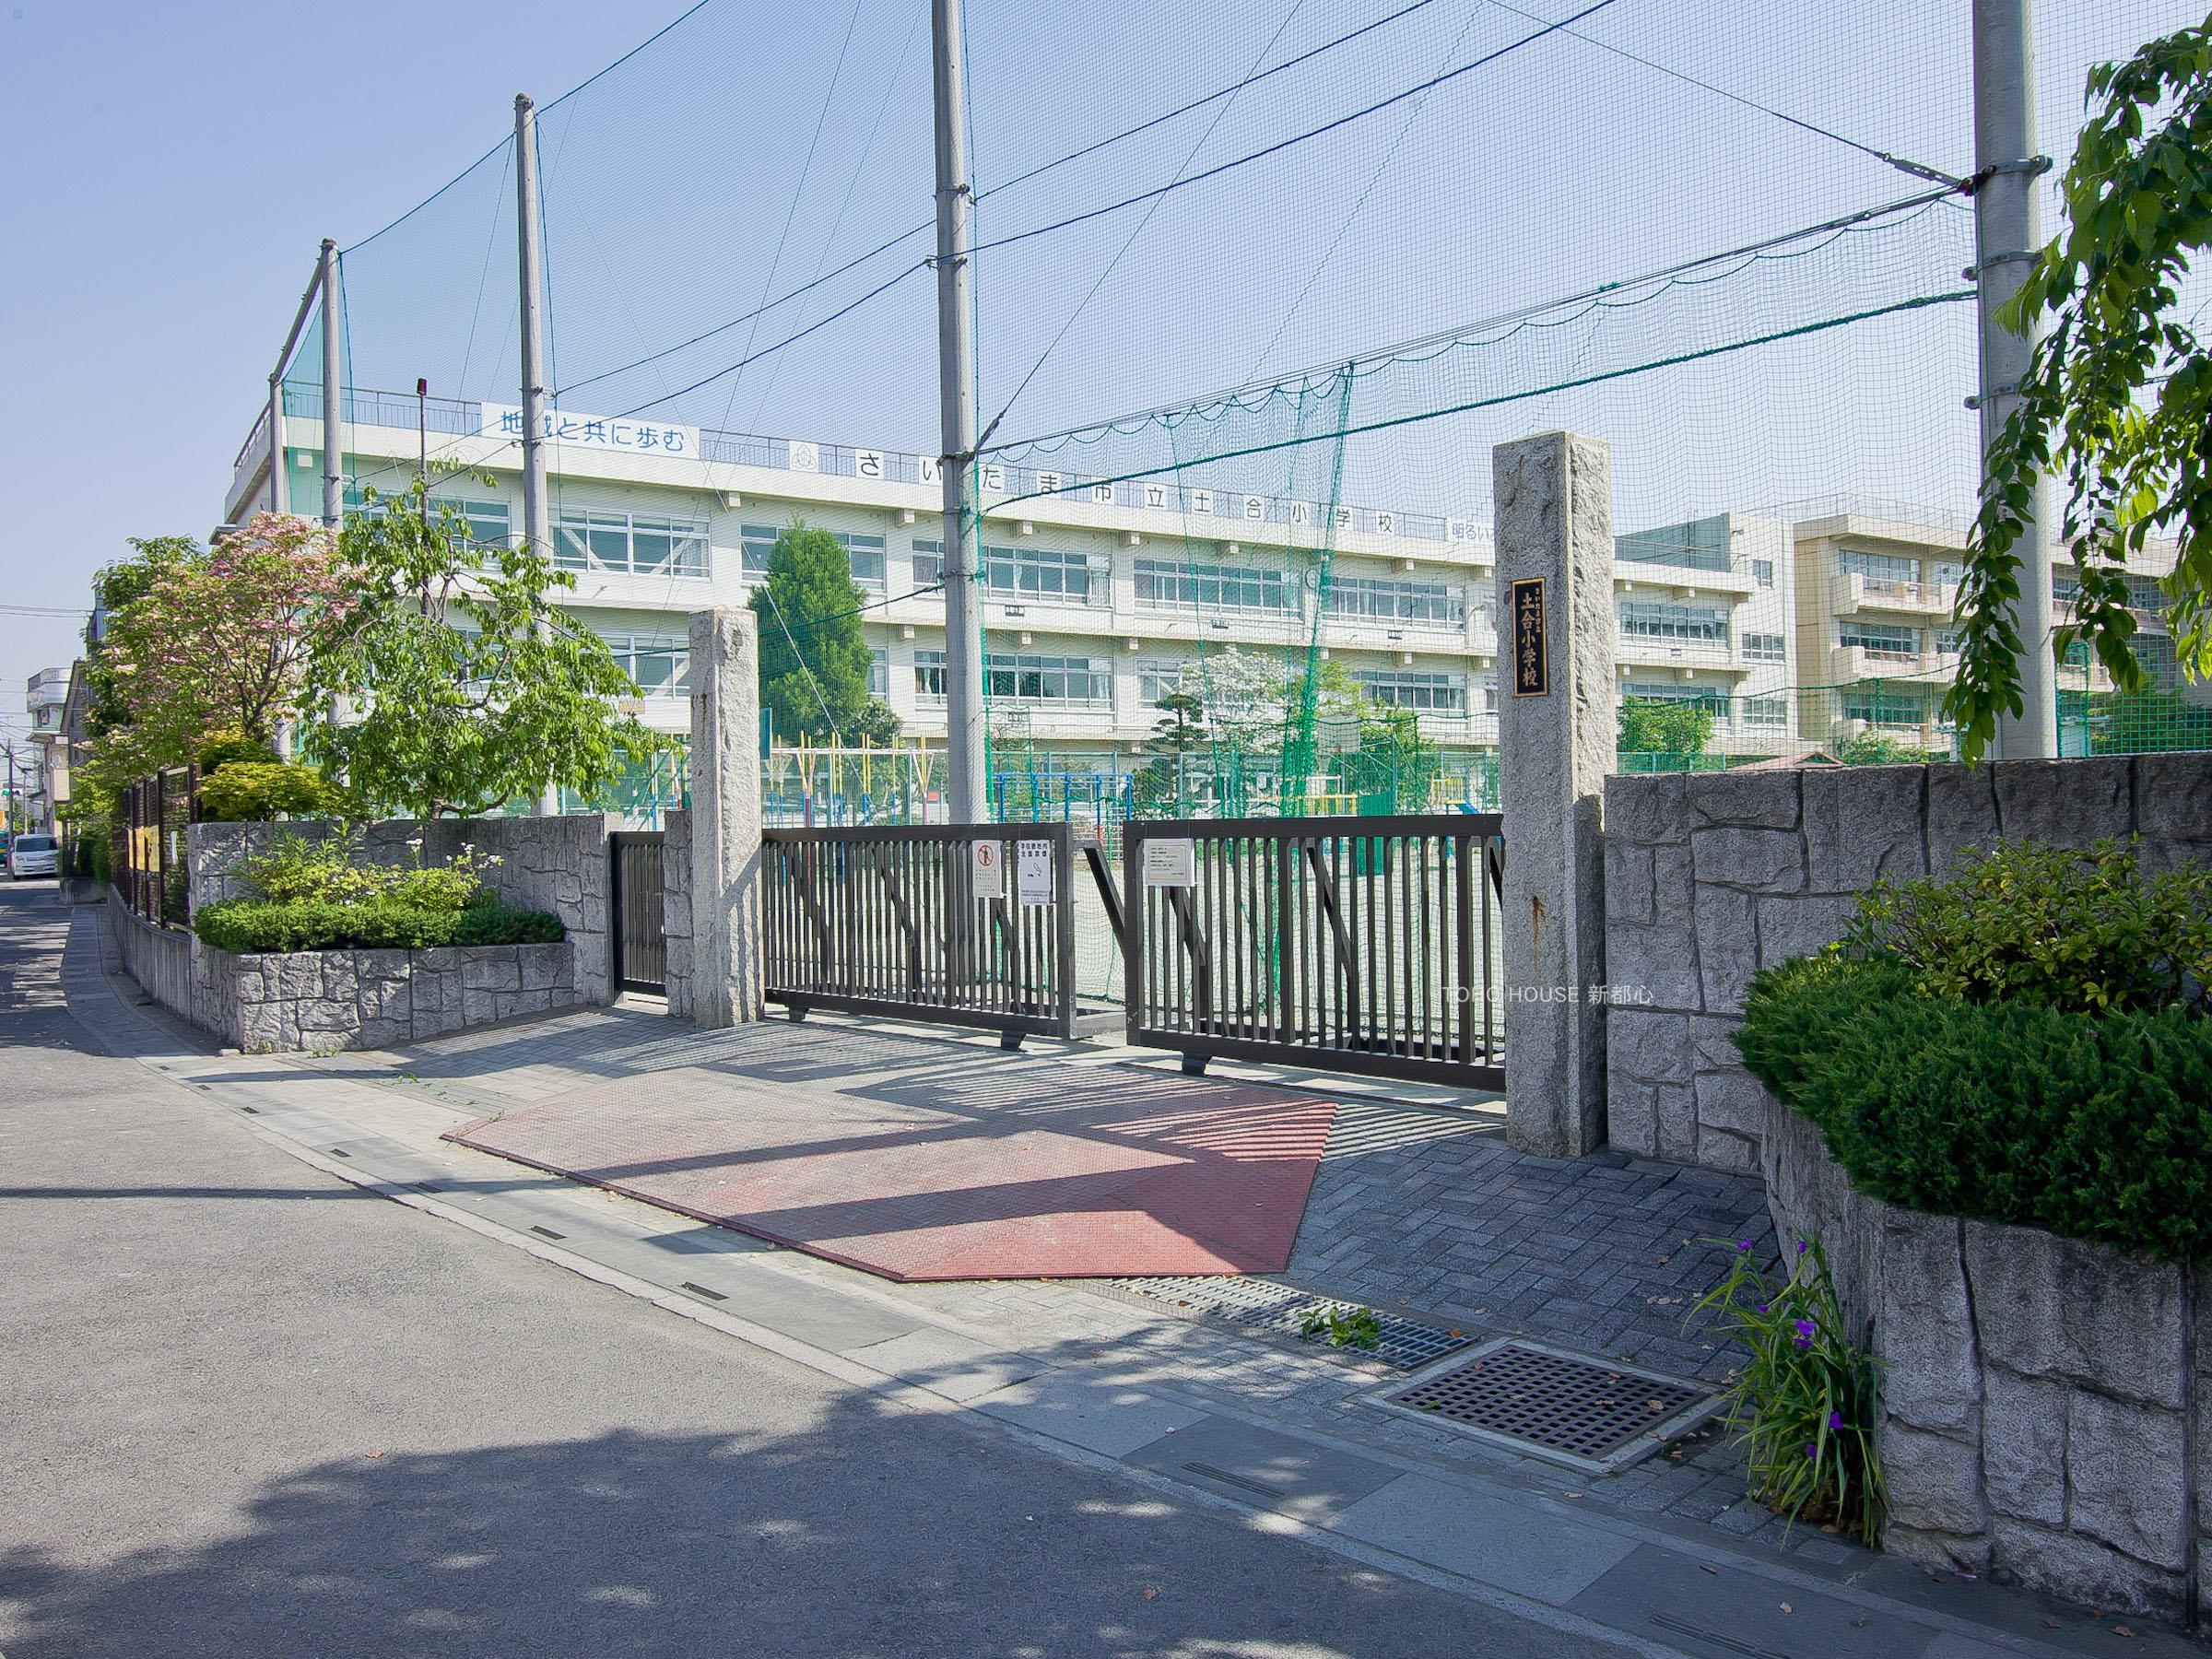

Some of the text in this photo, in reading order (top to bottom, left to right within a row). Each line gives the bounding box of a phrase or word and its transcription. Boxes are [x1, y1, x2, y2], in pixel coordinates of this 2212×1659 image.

[1452, 523, 1494, 541] 明るい
[1521, 592, 1538, 688] 土合小学校
